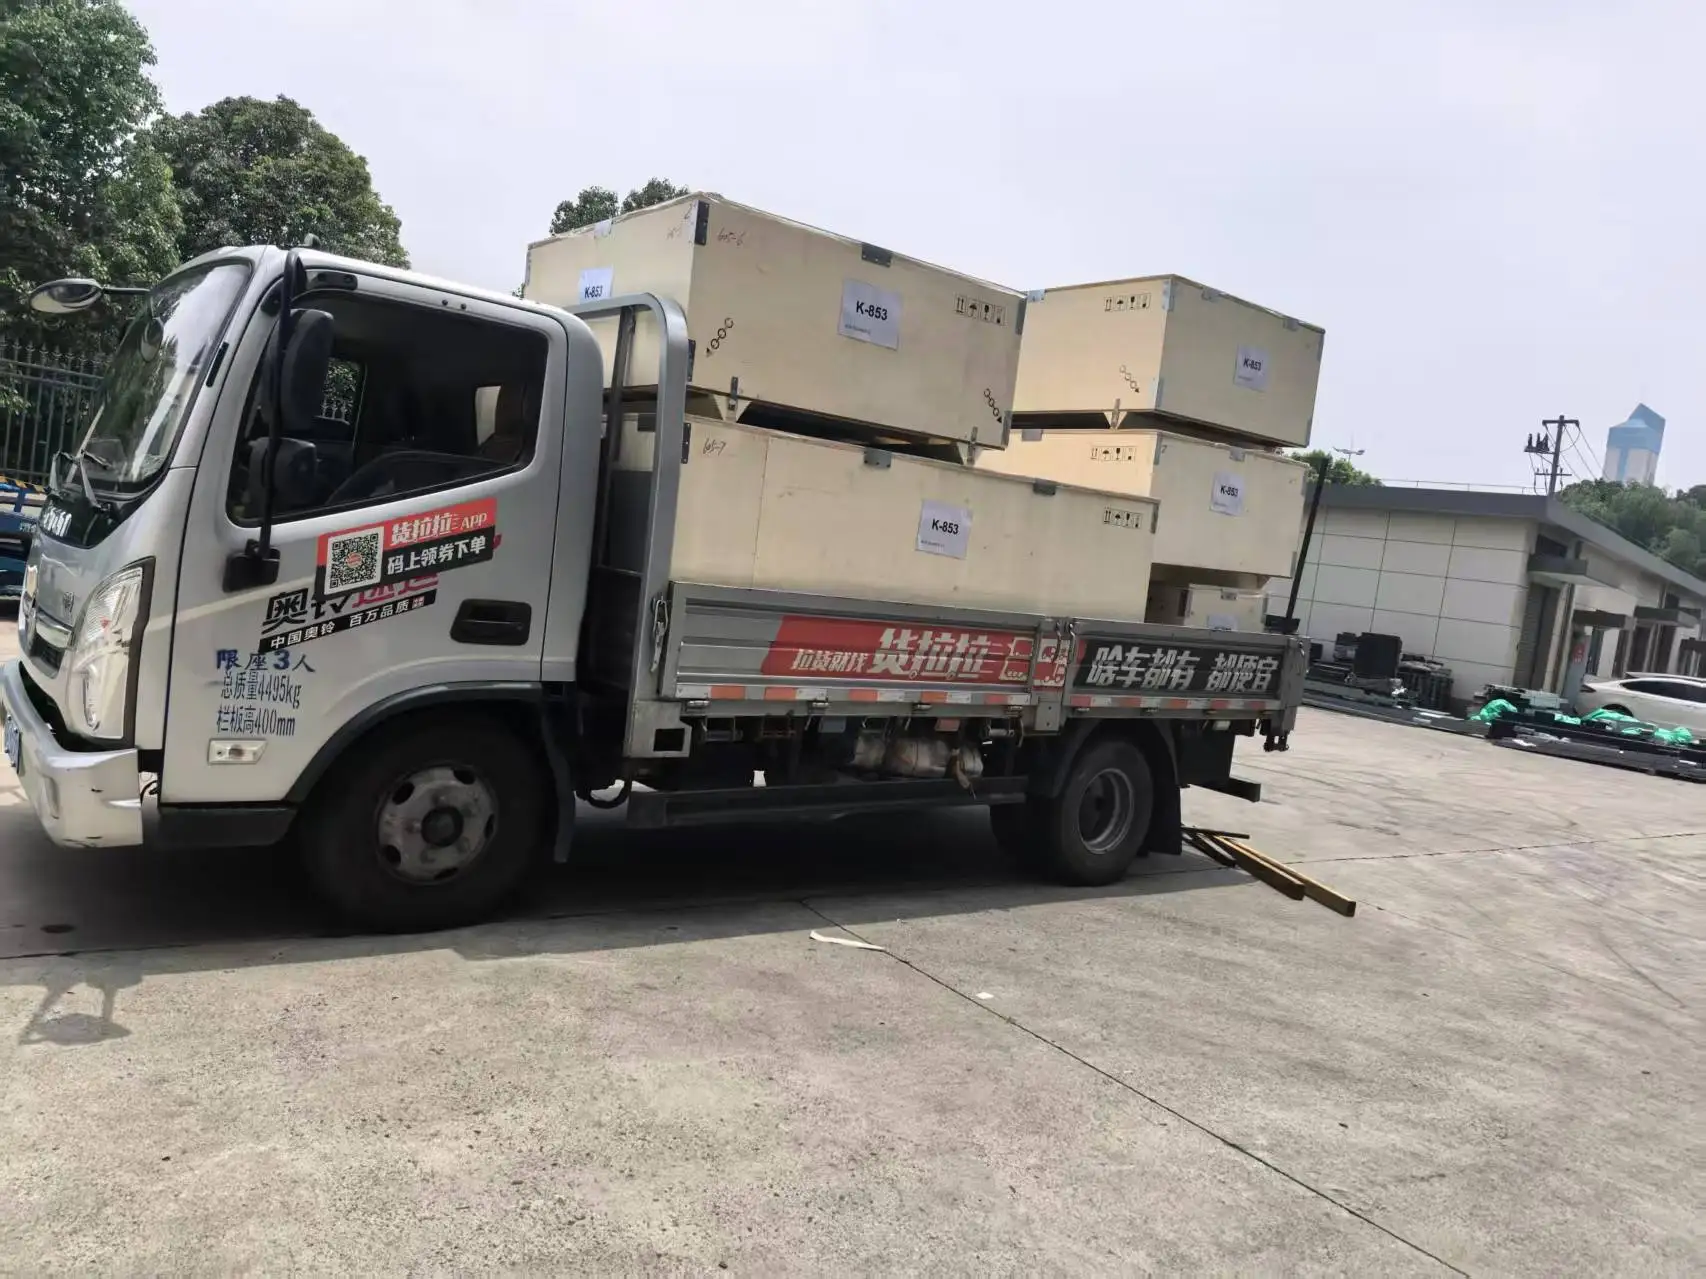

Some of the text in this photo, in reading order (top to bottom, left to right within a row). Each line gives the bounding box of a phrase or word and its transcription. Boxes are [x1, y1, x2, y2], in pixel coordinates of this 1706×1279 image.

[856, 300, 888, 321] K-853
[1243, 357, 1262, 371] K-853
[1220, 485, 1239, 498] K-853
[390, 512, 487, 546] 货拉拉 APP
[931, 518, 959, 535] K-853
[387, 535, 486, 575] 码上领券下单
[271, 621, 336, 649] 中国奥铃
[350, 599, 410, 628] 百万品质
[216, 648, 316, 673] 限座3人
[866, 628, 992, 679] 货拉拉
[221, 671, 302, 709] 总质量4495kg
[217, 703, 296, 736] 栏板高400mm
